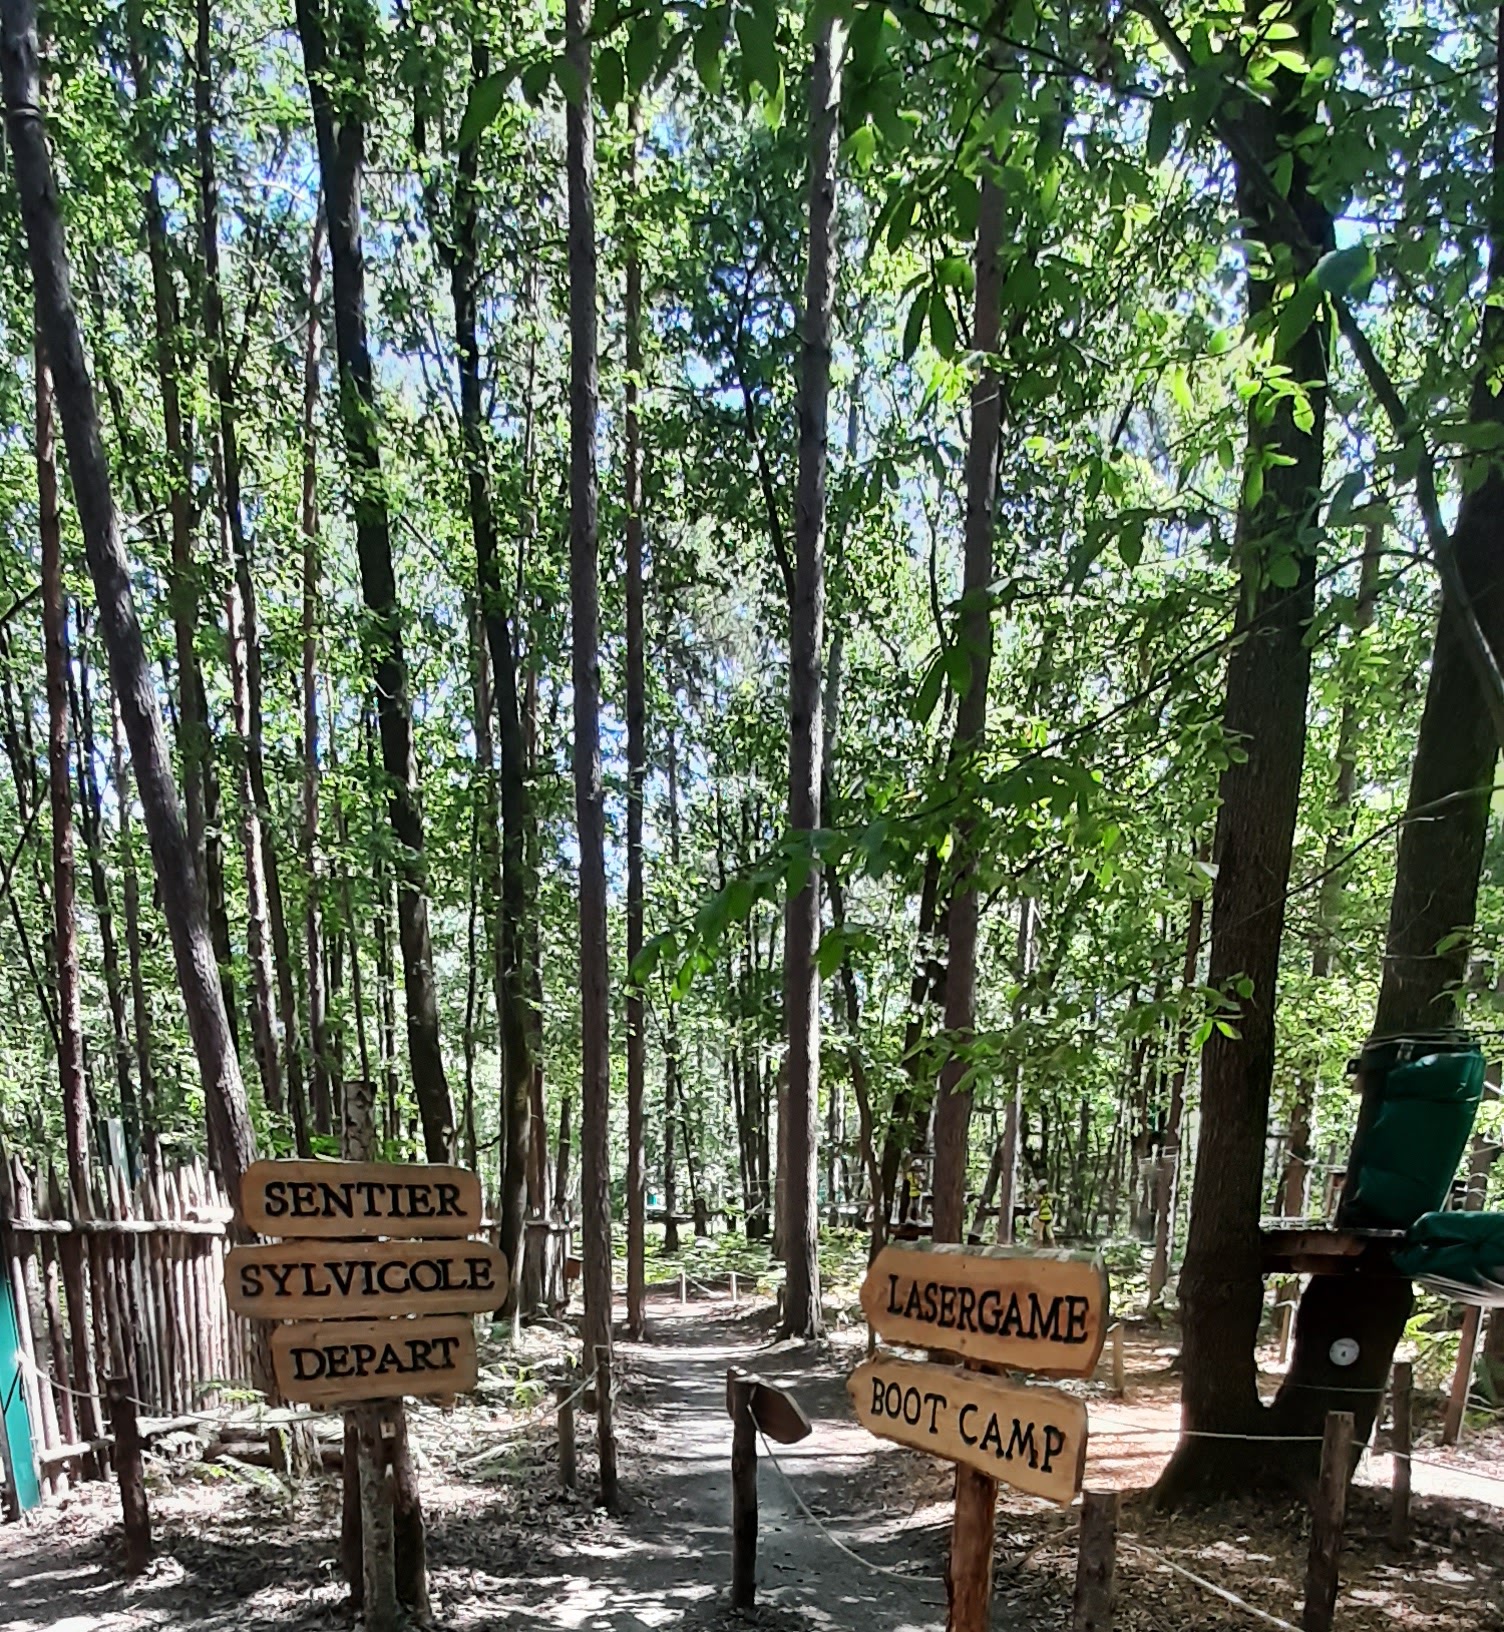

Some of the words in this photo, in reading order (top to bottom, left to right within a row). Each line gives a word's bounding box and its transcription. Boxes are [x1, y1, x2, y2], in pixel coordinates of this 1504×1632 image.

[264, 1181, 468, 1218] SENTIER
[239, 1257, 496, 1298] SYLVICOLE
[886, 1274, 1089, 1345] LASERGAME
[289, 1336, 460, 1381] DEPART
[870, 1376, 948, 1434] BOOT
[958, 1403, 1066, 1474] CAMP
